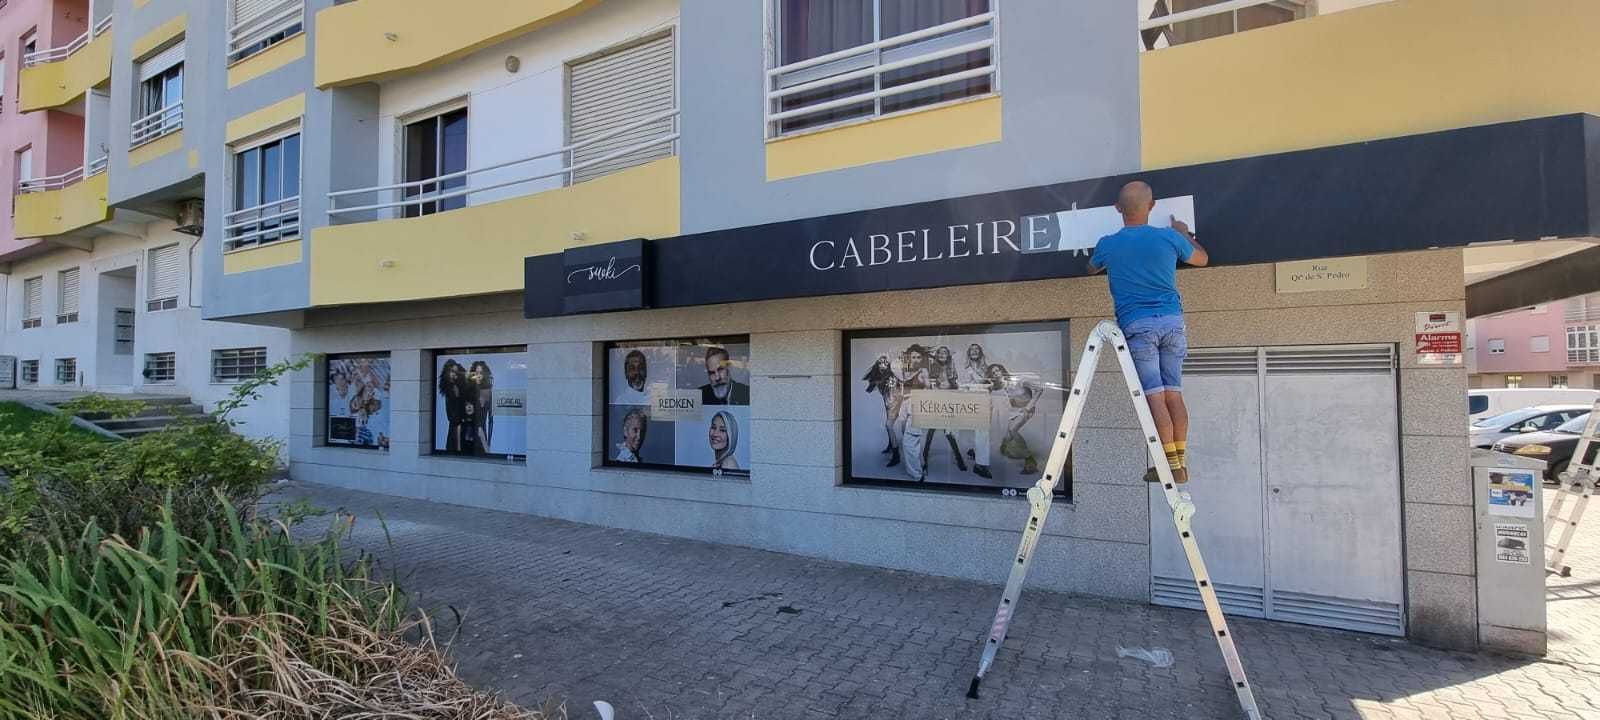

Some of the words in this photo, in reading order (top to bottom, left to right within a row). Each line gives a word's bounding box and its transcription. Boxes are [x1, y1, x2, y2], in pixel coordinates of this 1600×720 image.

[1312, 264, 1328, 272] Rua
[1327, 271, 1351, 281] Pedro
[658, 398, 694, 409] REDKEN
